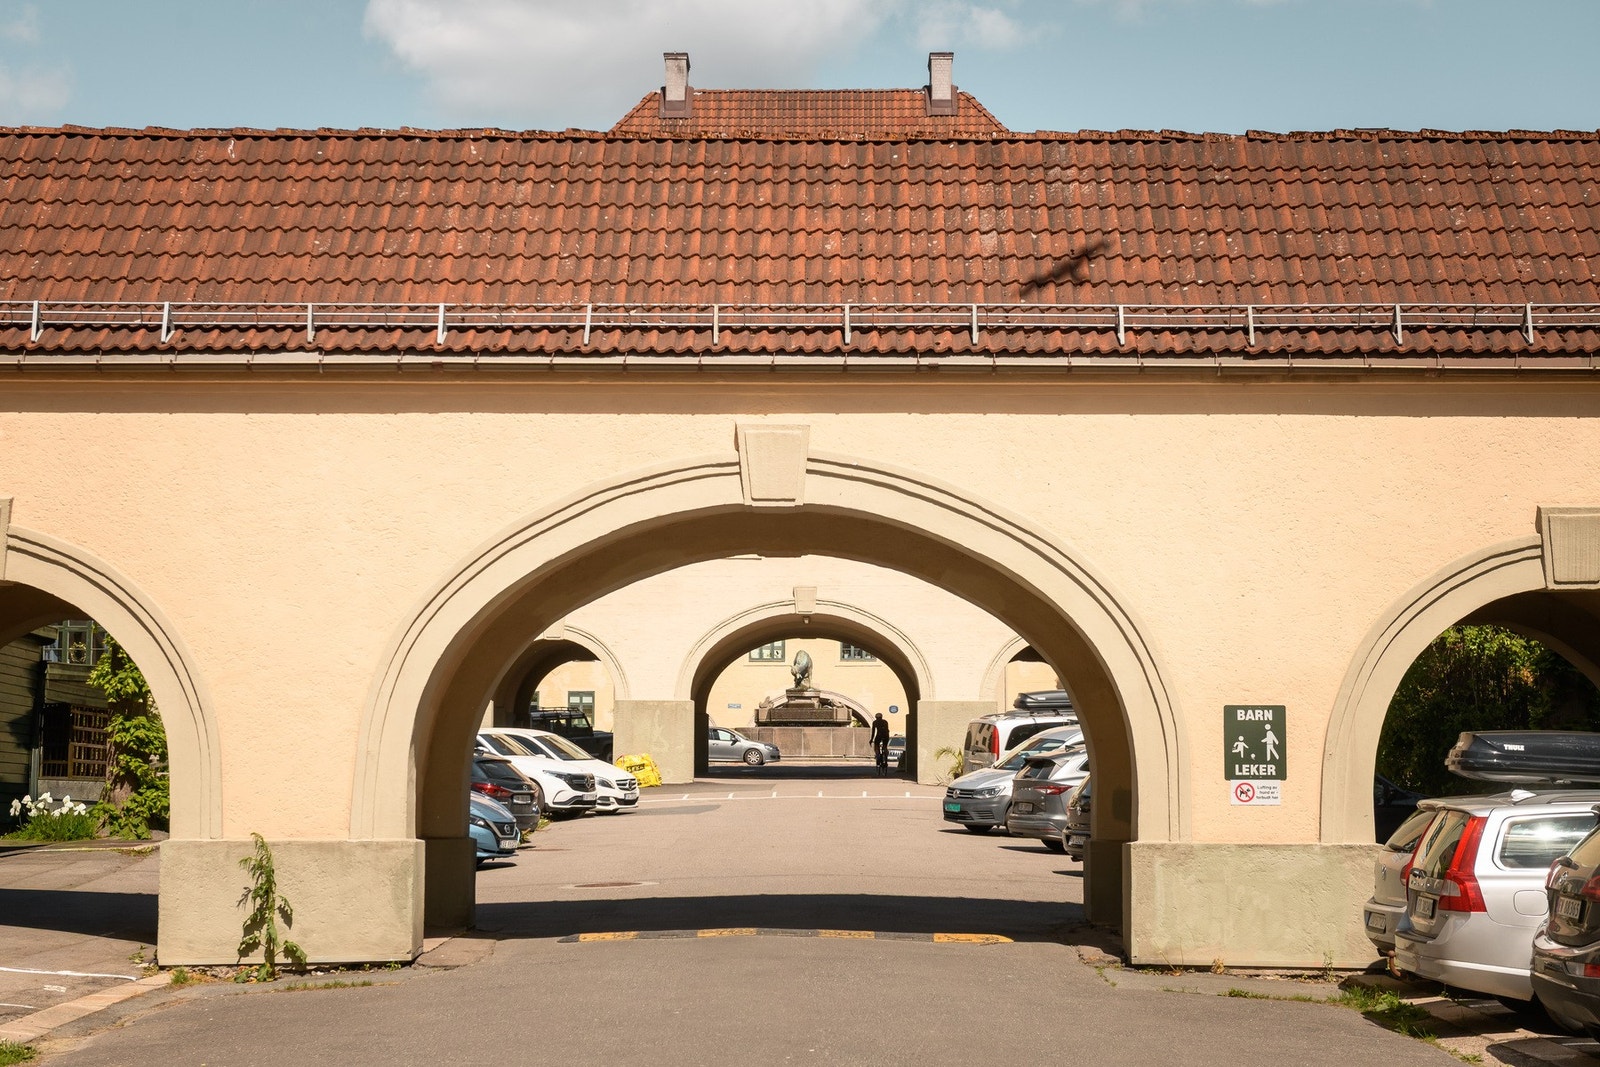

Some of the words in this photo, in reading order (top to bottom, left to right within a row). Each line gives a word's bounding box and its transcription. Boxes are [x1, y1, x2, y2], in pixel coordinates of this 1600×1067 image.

[1237, 709, 1273, 721] BARN
[1503, 743, 1525, 751] THULE
[1235, 764, 1276, 776] LEKER
